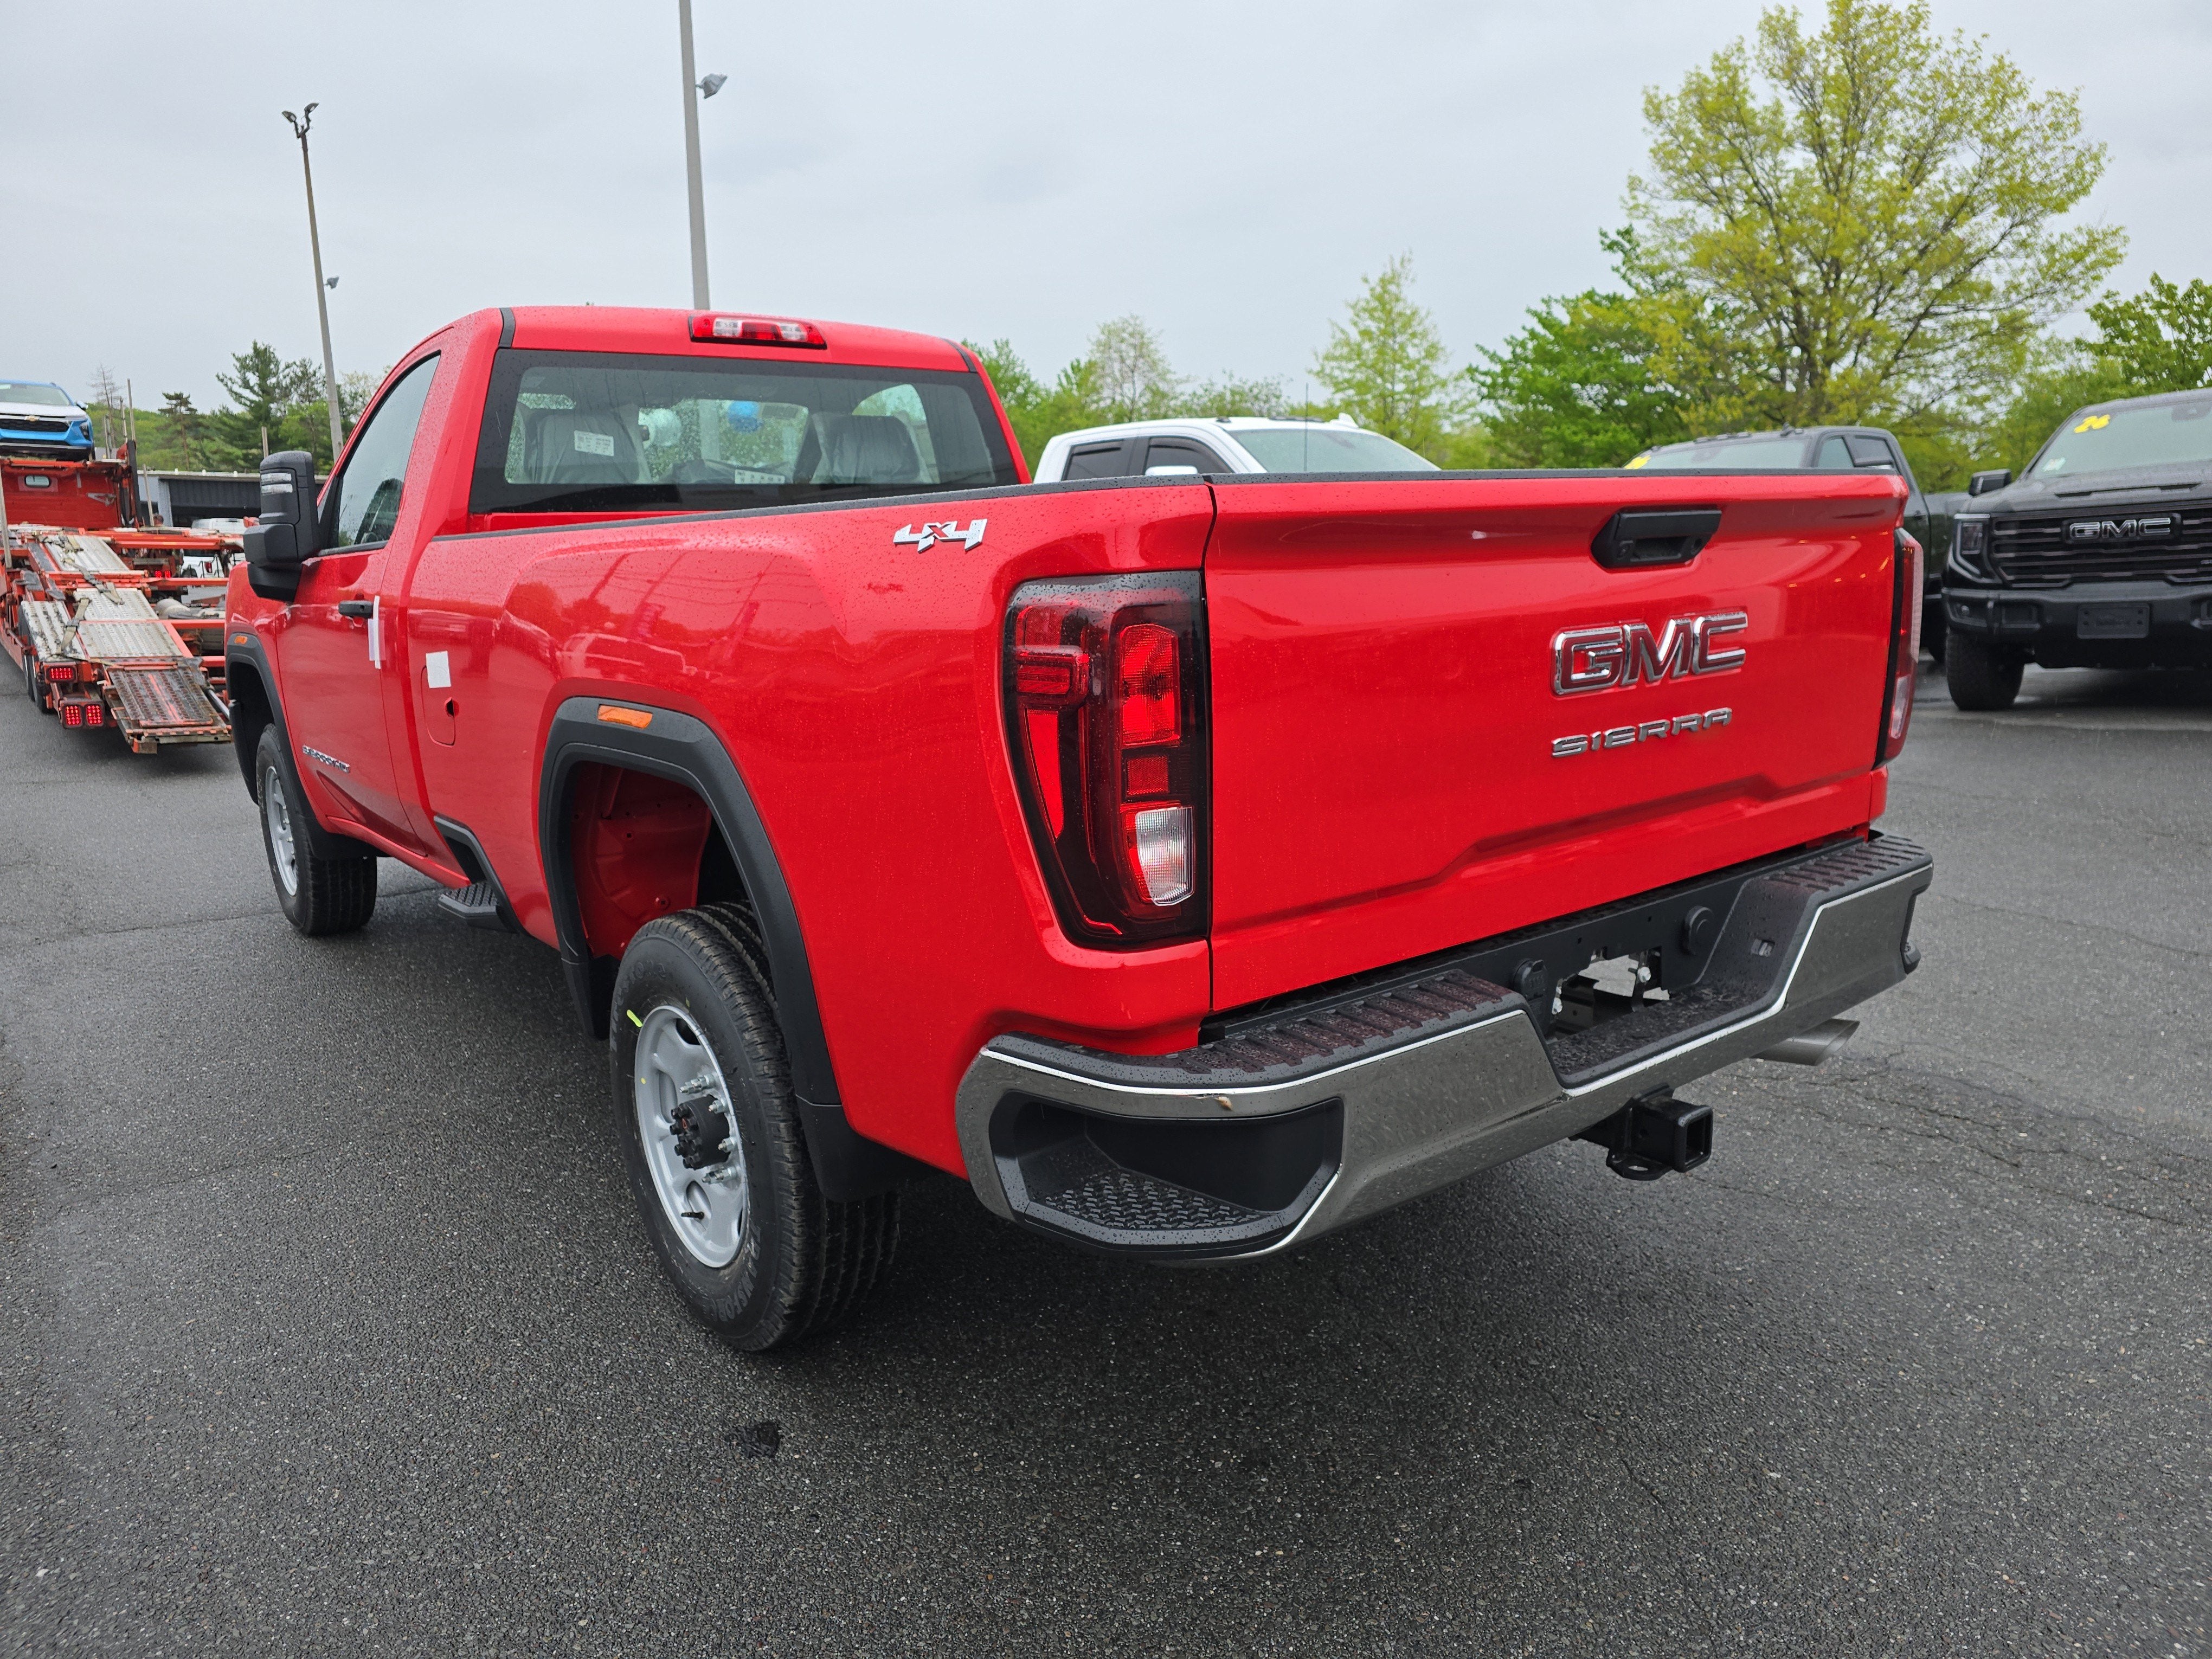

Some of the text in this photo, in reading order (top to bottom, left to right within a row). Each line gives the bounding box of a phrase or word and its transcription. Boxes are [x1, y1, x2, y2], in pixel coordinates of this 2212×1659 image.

[2069, 517, 2171, 539] GMC
[1552, 610, 1748, 696] GMC
[1552, 707, 1733, 758] SIERRA
